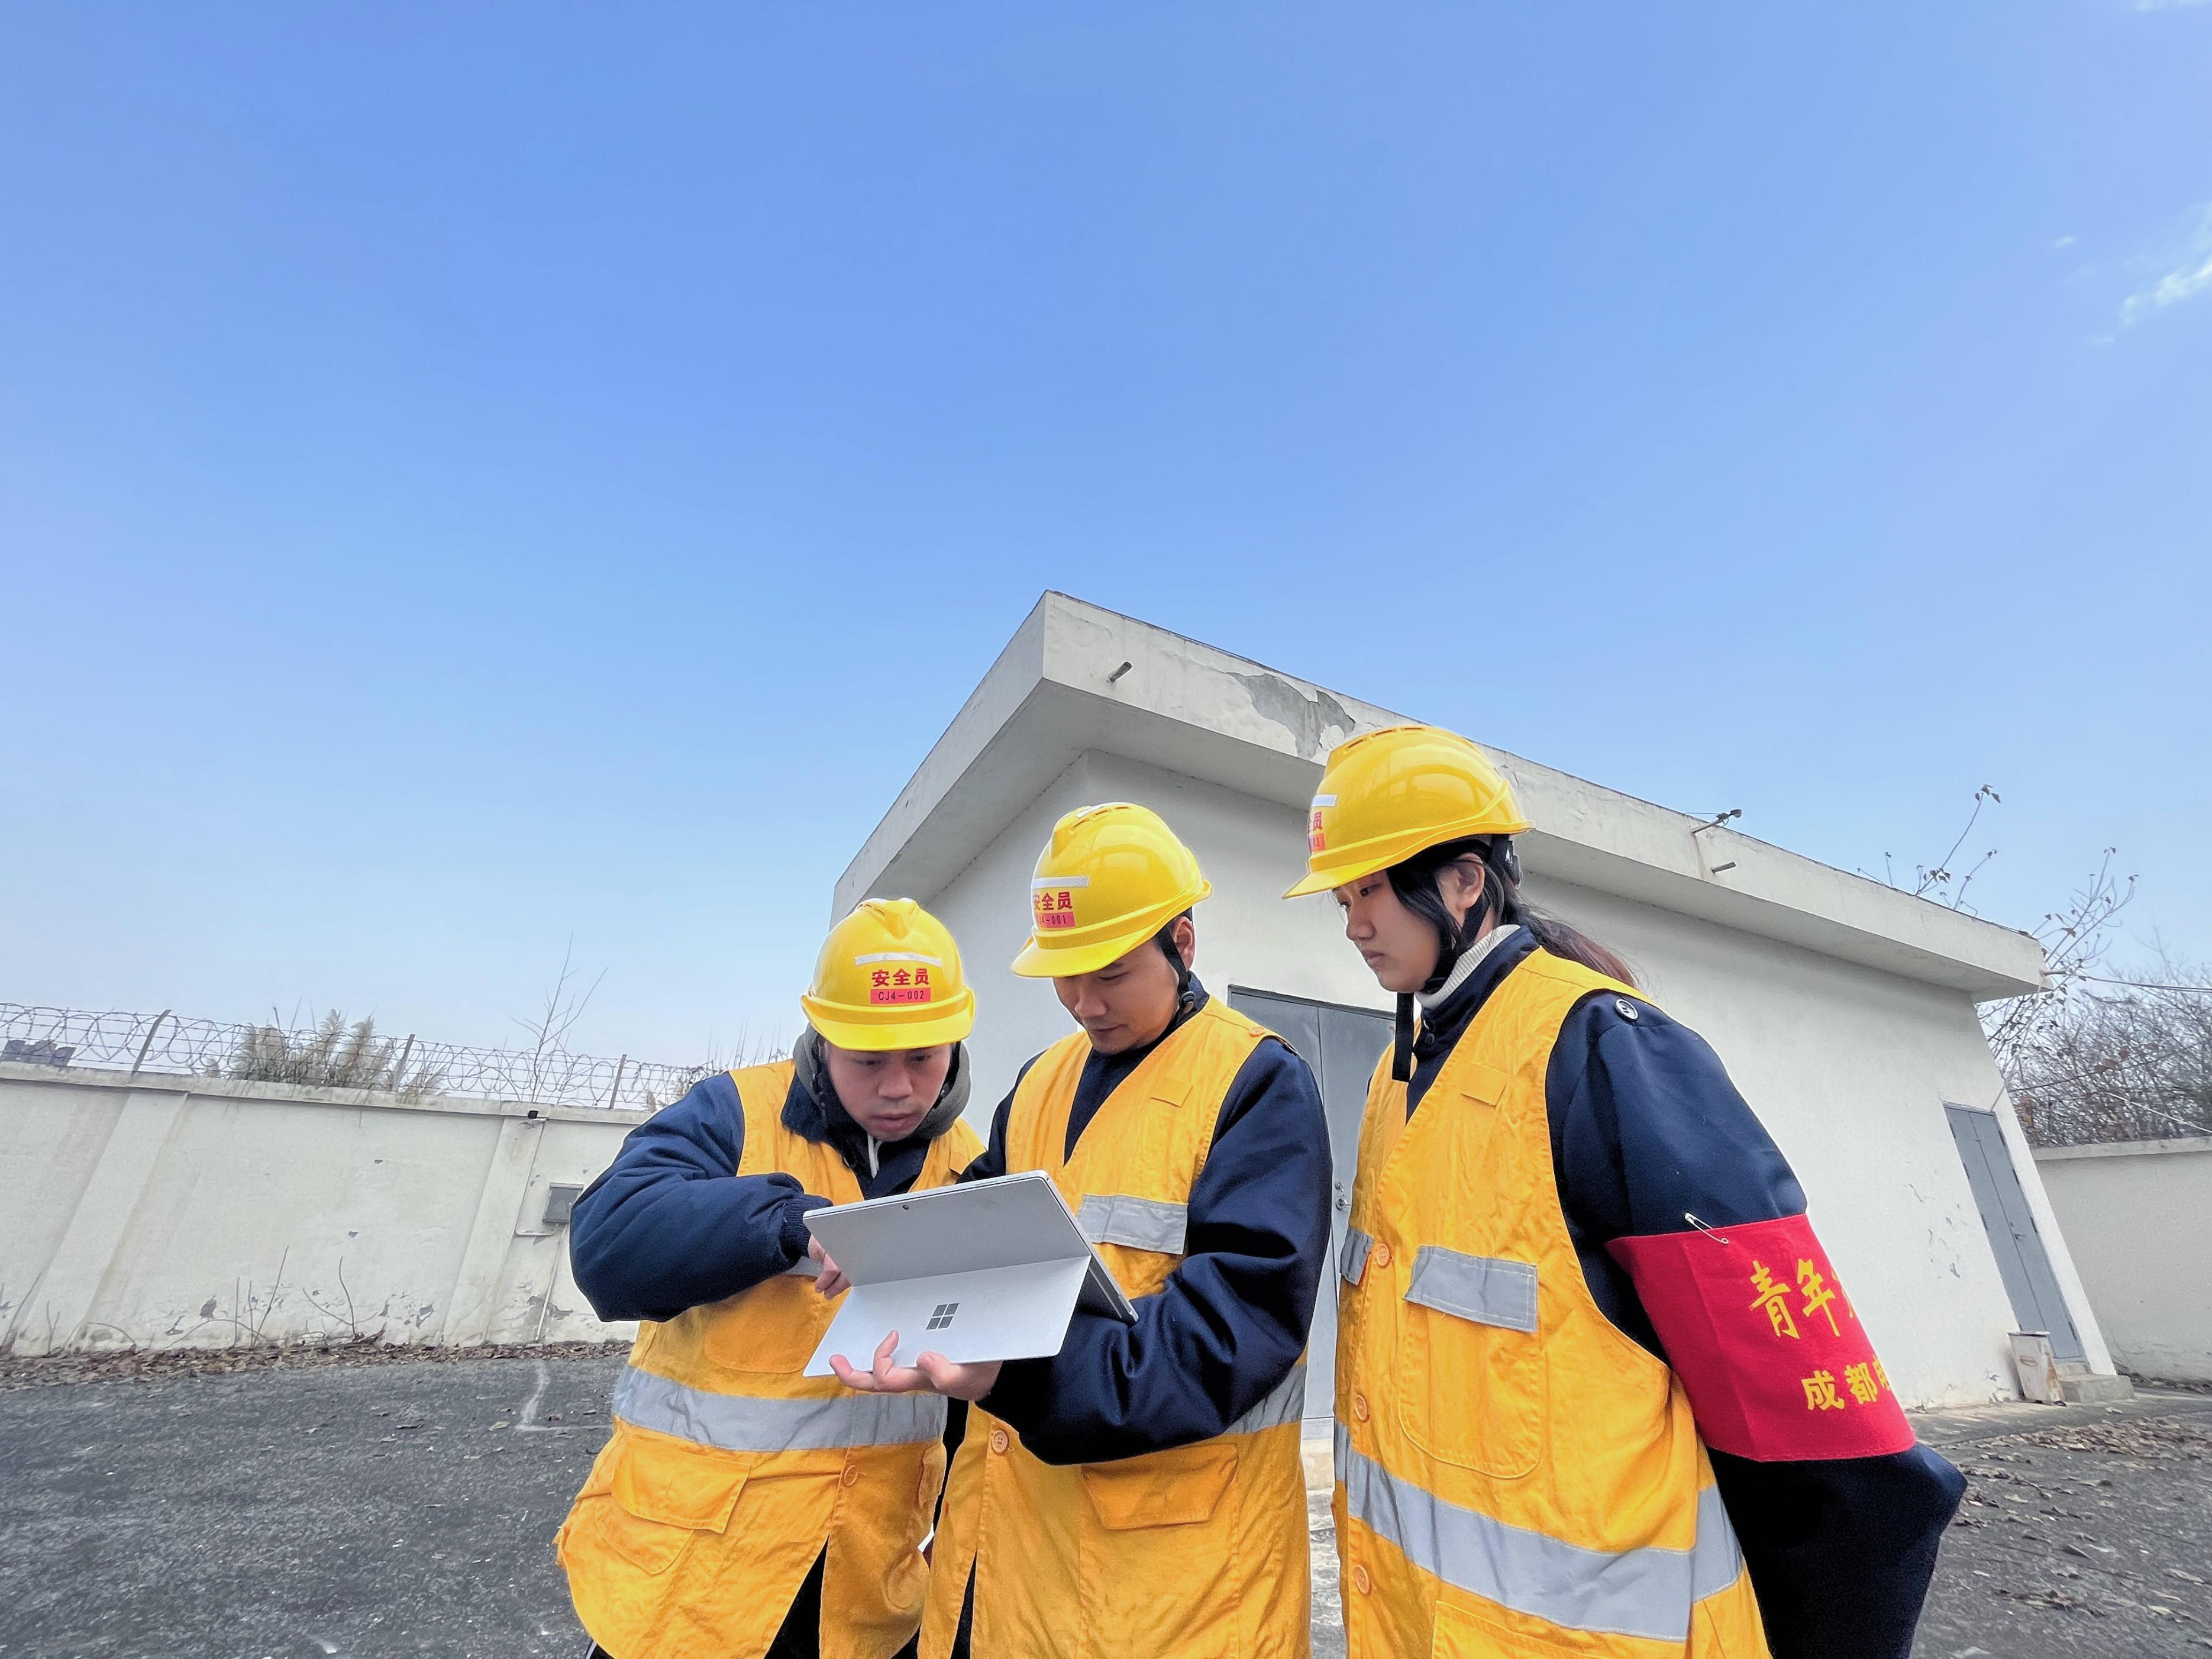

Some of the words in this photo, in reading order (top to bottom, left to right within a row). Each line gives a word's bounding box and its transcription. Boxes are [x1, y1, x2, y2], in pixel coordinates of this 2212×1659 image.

[871, 969, 929, 987] 安全员
[878, 990, 924, 1000] CJ4-002
[1749, 1258, 1853, 1339] 青年
